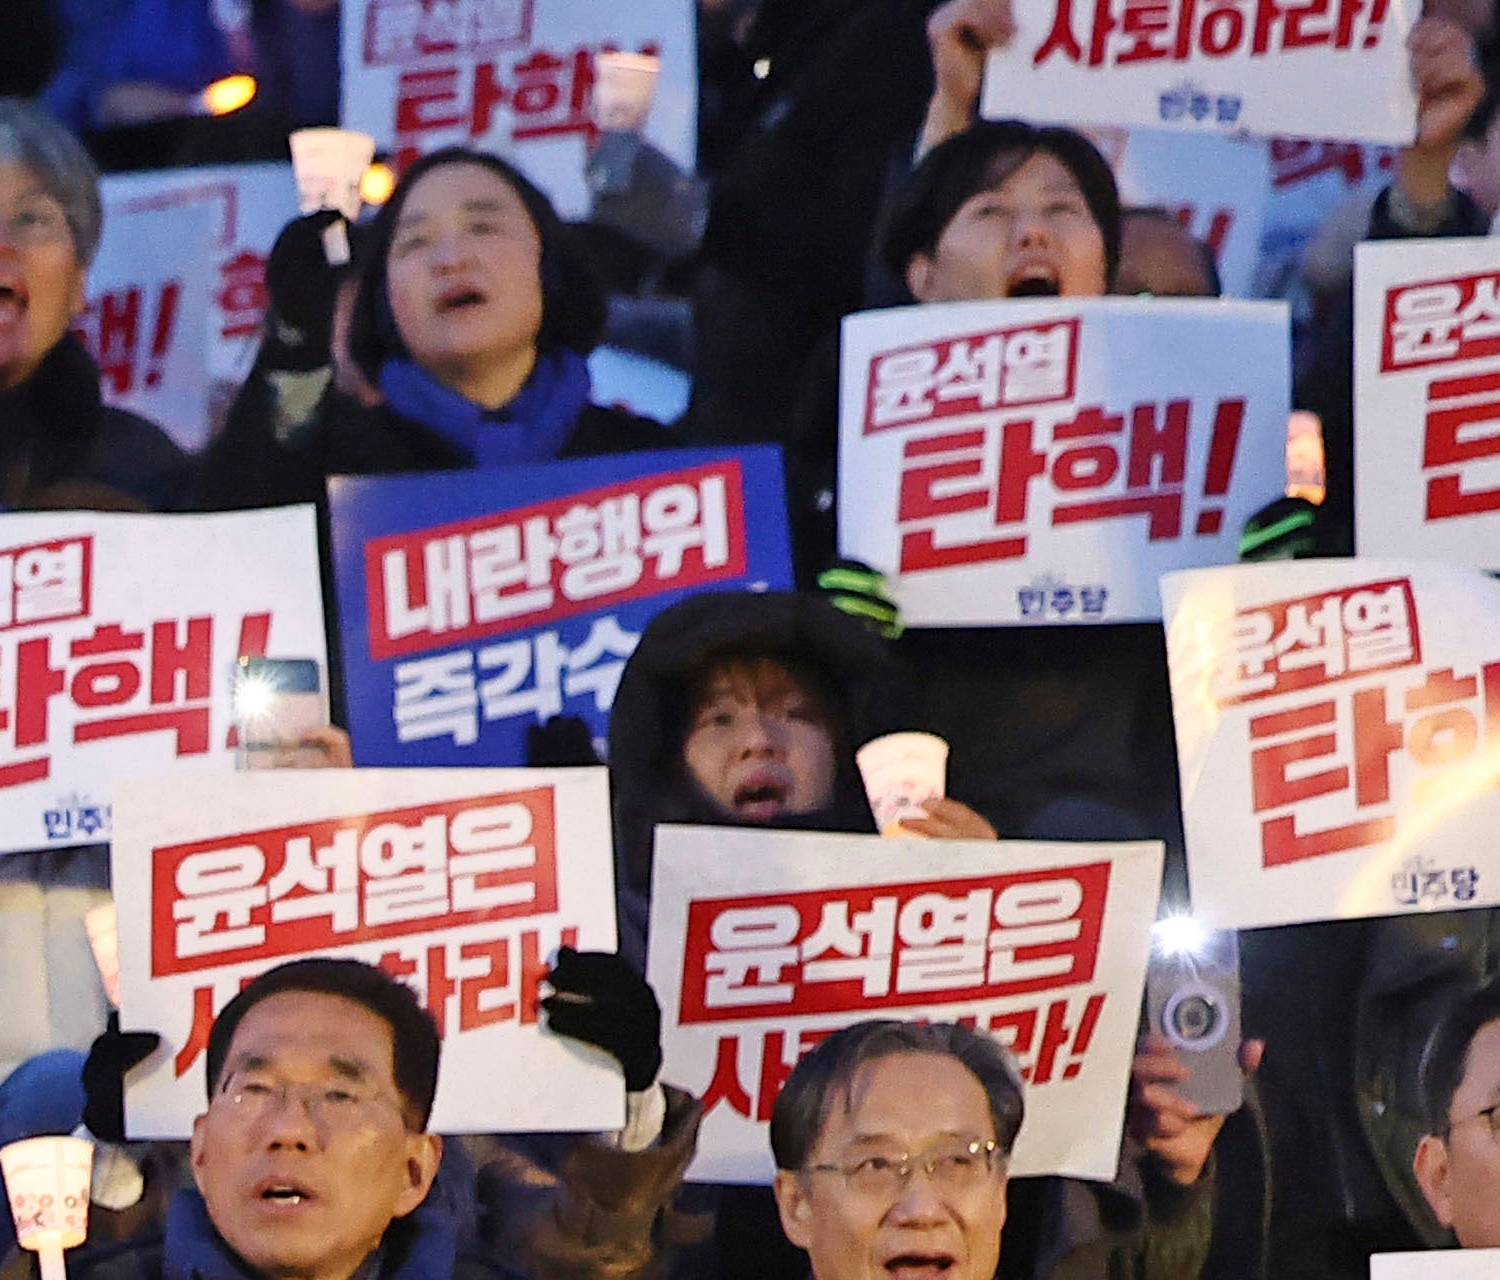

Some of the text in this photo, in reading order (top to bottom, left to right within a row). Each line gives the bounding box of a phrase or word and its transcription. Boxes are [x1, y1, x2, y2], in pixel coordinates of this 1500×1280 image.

[869, 324, 1066, 426] 윤석열
[898, 400, 1246, 574] 탄핵!
[383, 477, 734, 640] 내란행위
[1017, 588, 1108, 621] 민주당
[1219, 582, 1406, 691] 윤석열
[45, 806, 113, 838] 민주
[172, 805, 535, 953] 윤석열은
[705, 879, 1082, 1004] 윤석열은
